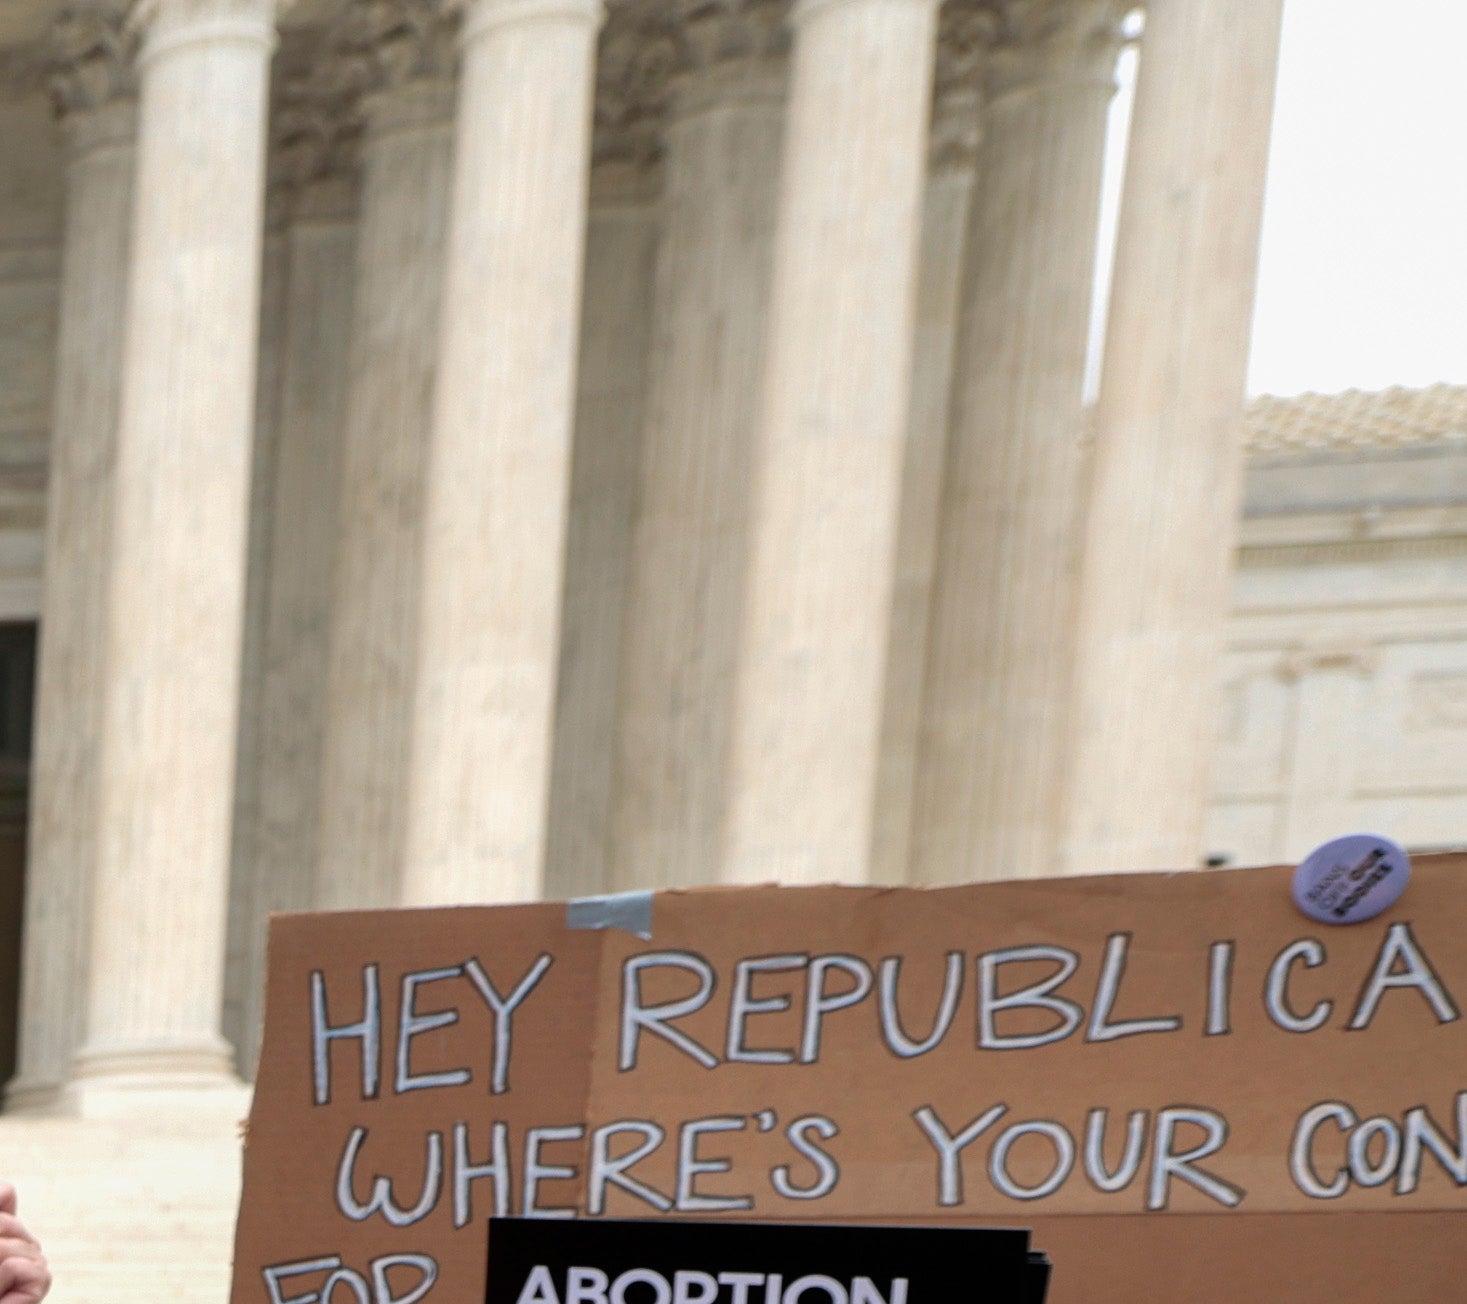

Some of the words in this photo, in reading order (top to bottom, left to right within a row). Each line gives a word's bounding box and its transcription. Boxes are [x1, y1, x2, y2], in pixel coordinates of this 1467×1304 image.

[311, 953, 554, 1106] HEY
[618, 922, 1461, 1072] REPUBLICA
[336, 1108, 841, 1230] WHERE'S
[913, 1103, 1246, 1211] YOUR
